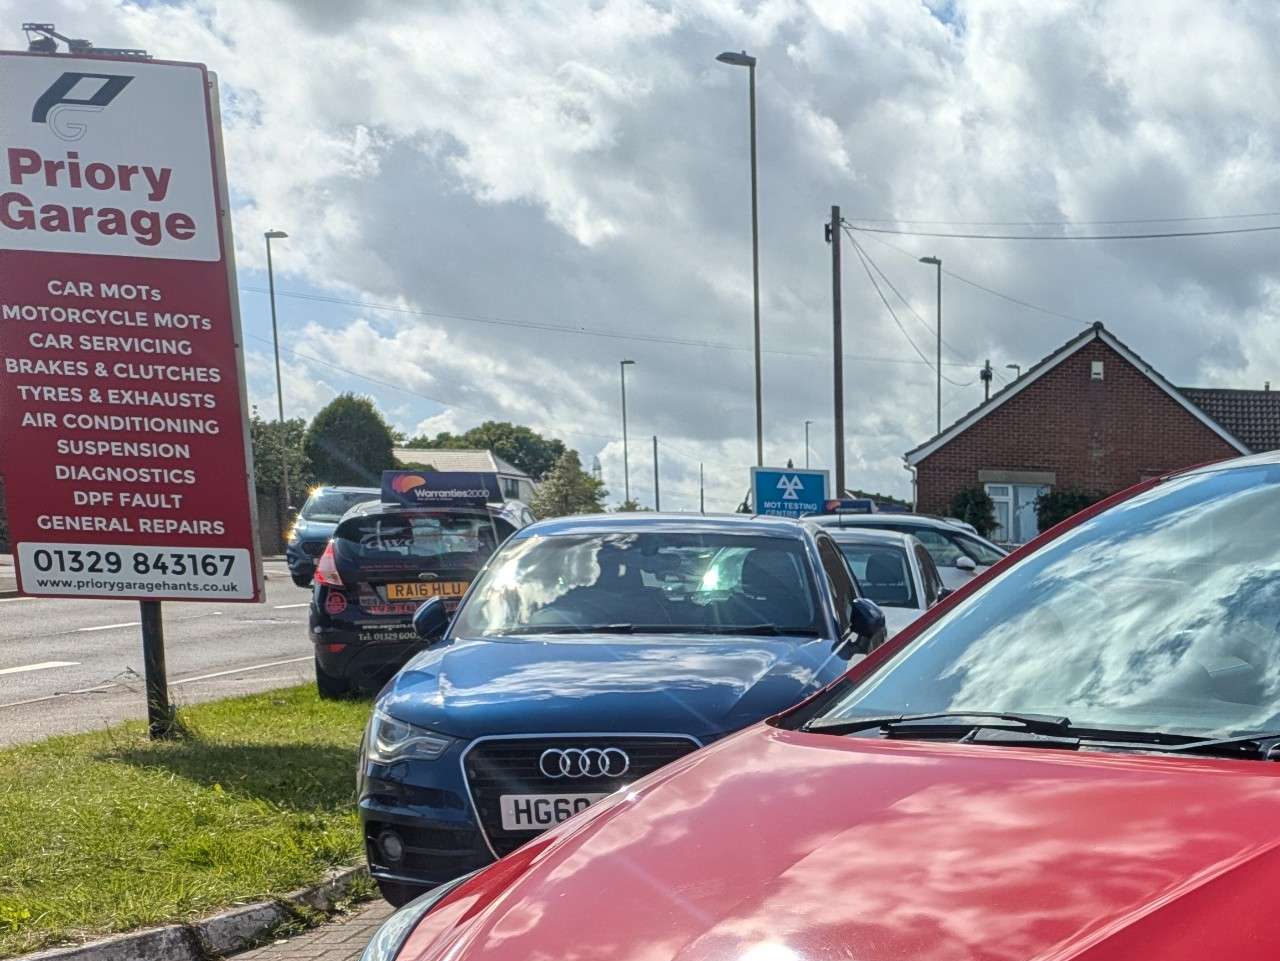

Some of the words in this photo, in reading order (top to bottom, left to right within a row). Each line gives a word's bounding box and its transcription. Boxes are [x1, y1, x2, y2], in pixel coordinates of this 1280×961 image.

[8, 148, 172, 202] Priory
[0, 191, 196, 246] Garage
[48, 280, 93, 298] CAR
[100, 283, 161, 301] MOTs
[2, 304, 148, 327] MOTORCYCLE
[154, 312, 212, 331] MOTs
[29, 333, 73, 350] CAR
[79, 336, 193, 356] SERVICING
[5, 358, 88, 377] BRAKES
[96, 362, 109, 378] &
[114, 363, 221, 383] CLUTCHES
[17, 386, 83, 403] TYRES
[89, 388, 103, 403] &
[108, 389, 216, 409] EXHAUSTS
[22, 412, 57, 429] AIR
[63, 414, 219, 435] CONDITIONING
[57, 439, 190, 459] SUSPENSION
[55, 465, 196, 484] DIAGNOSTICS
[74, 491, 113, 506] DPF
[120, 493, 183, 509] FAULT
[414, 488, 490, 498] Warranties2000
[763, 501, 781, 509] MOT
[784, 502, 818, 511] TESTING
[37, 515, 133, 533] GENERAL
[140, 518, 225, 535] REPAIRS
[33, 549, 123, 574] 01329
[133, 553, 236, 577] 843167
[37, 577, 239, 593] www.priorygaragehants.co.uk
[395, 582, 428, 597] RA16
[432, 582, 460, 596] HLU
